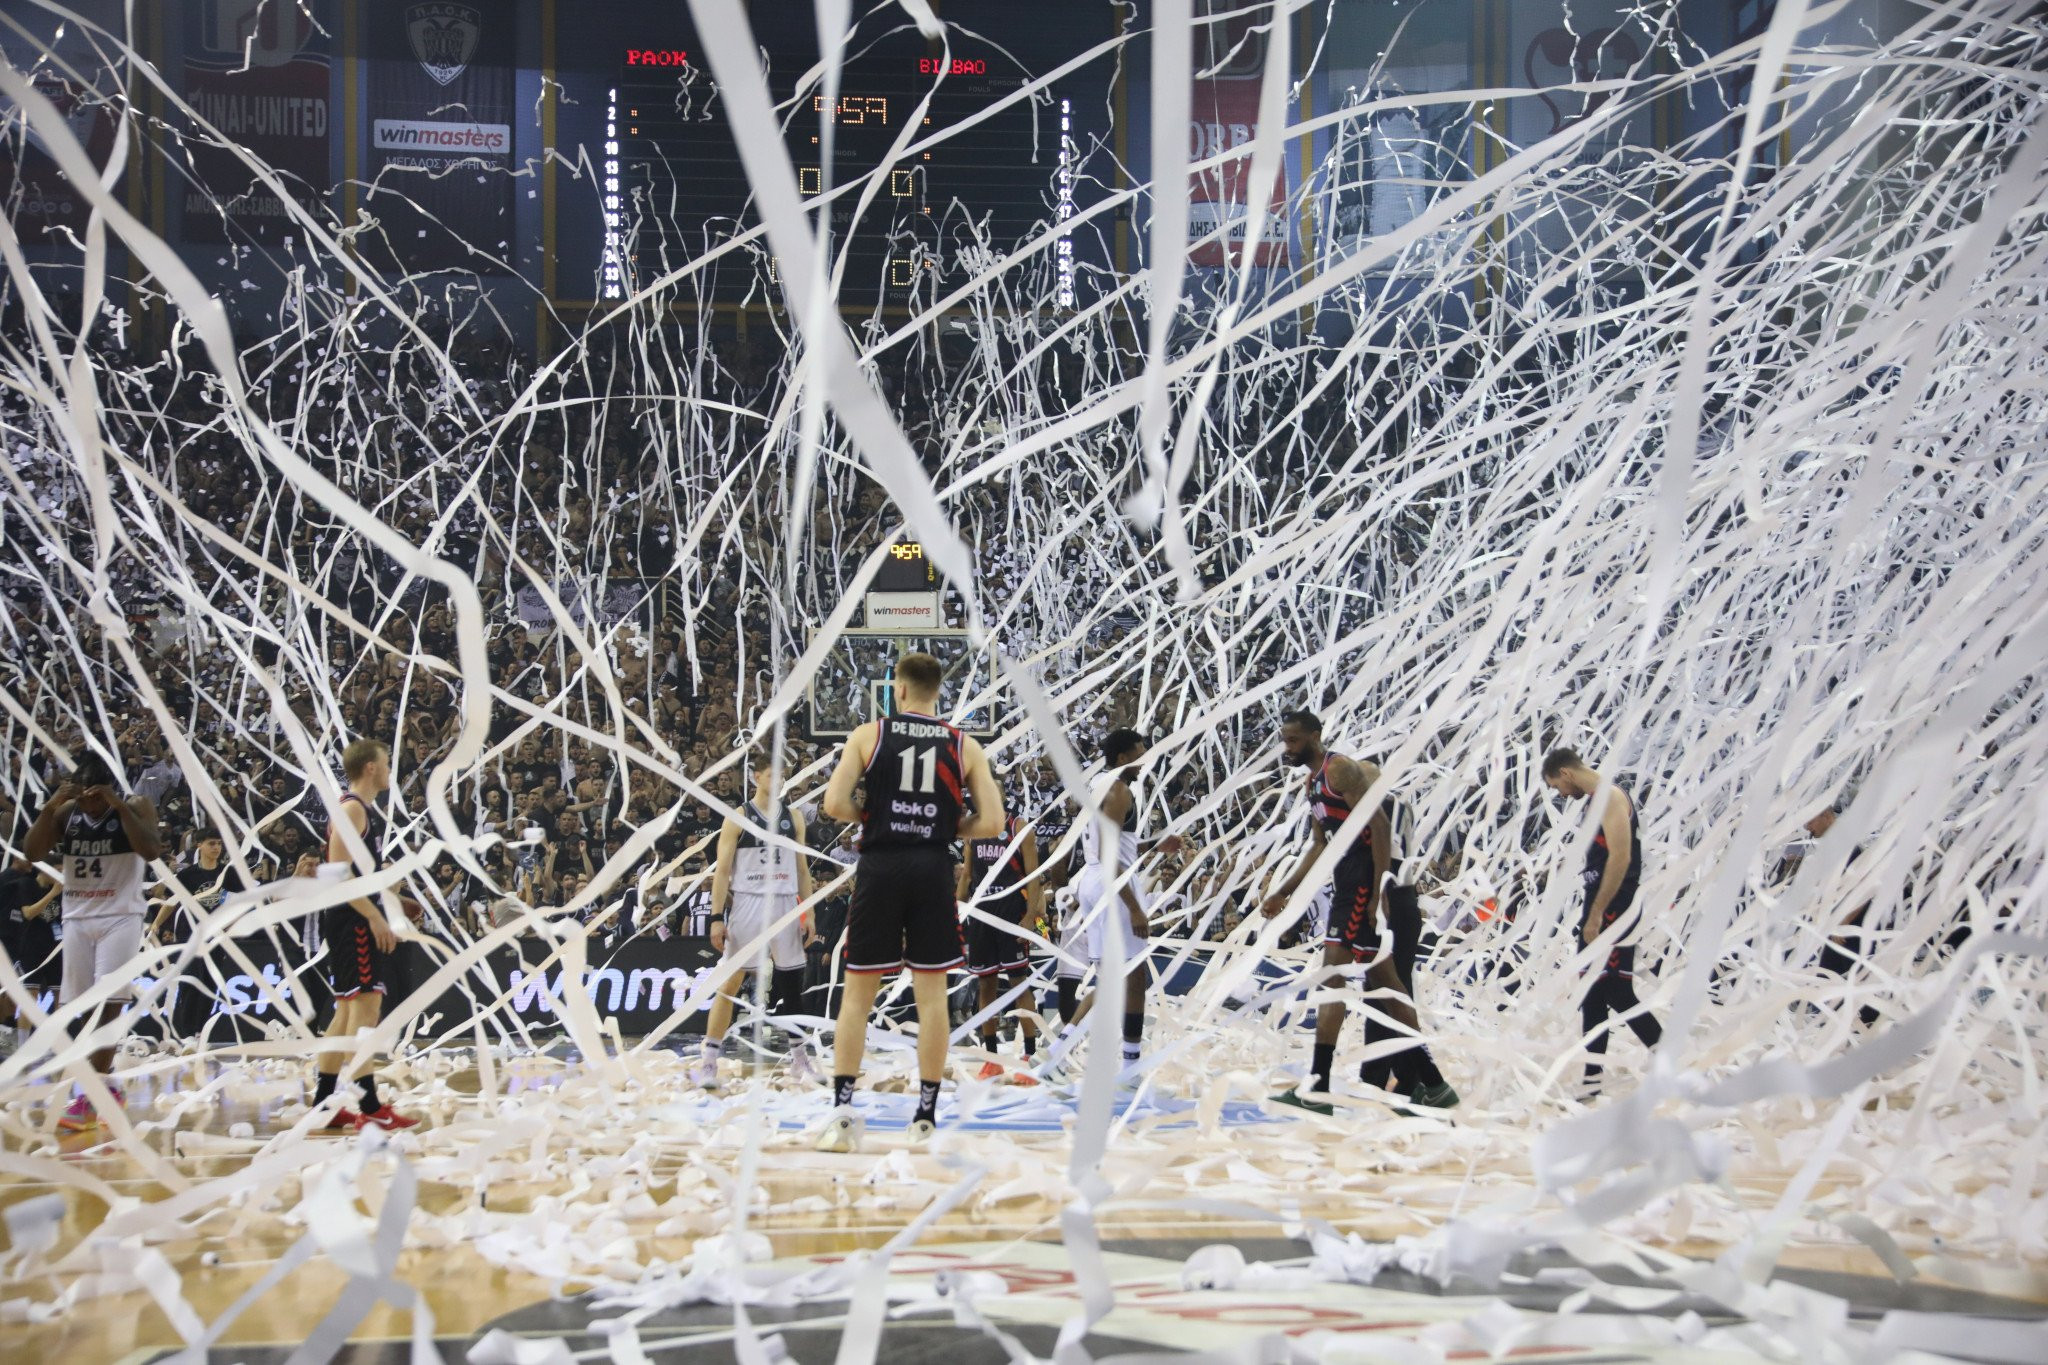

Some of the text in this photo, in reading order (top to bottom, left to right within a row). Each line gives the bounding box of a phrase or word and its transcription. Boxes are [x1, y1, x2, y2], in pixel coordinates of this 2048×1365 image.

[626, 49, 688, 66] PAOK
[920, 59, 986, 75] BIBAO
[608, 106, 616, 120] 2
[381, 125, 503, 147] winmasters
[386, 156, 441, 169] ΜΕΓΑΛΟΣ
[800, 167, 821, 194] 0
[892, 170, 912, 196] 0
[890, 544, 922, 559] 9:59
[873, 605, 931, 616] winmasters
[891, 722, 908, 734] DE
[908, 723, 950, 738] RIDDER
[898, 745, 937, 793] 11
[892, 800, 923, 816] bbk
[302, 810, 329, 824] CLU
[890, 820, 933, 838] vueling
[70, 840, 114, 855] PAOK
[74, 858, 103, 878] 24
[64, 888, 117, 898] winmasters
